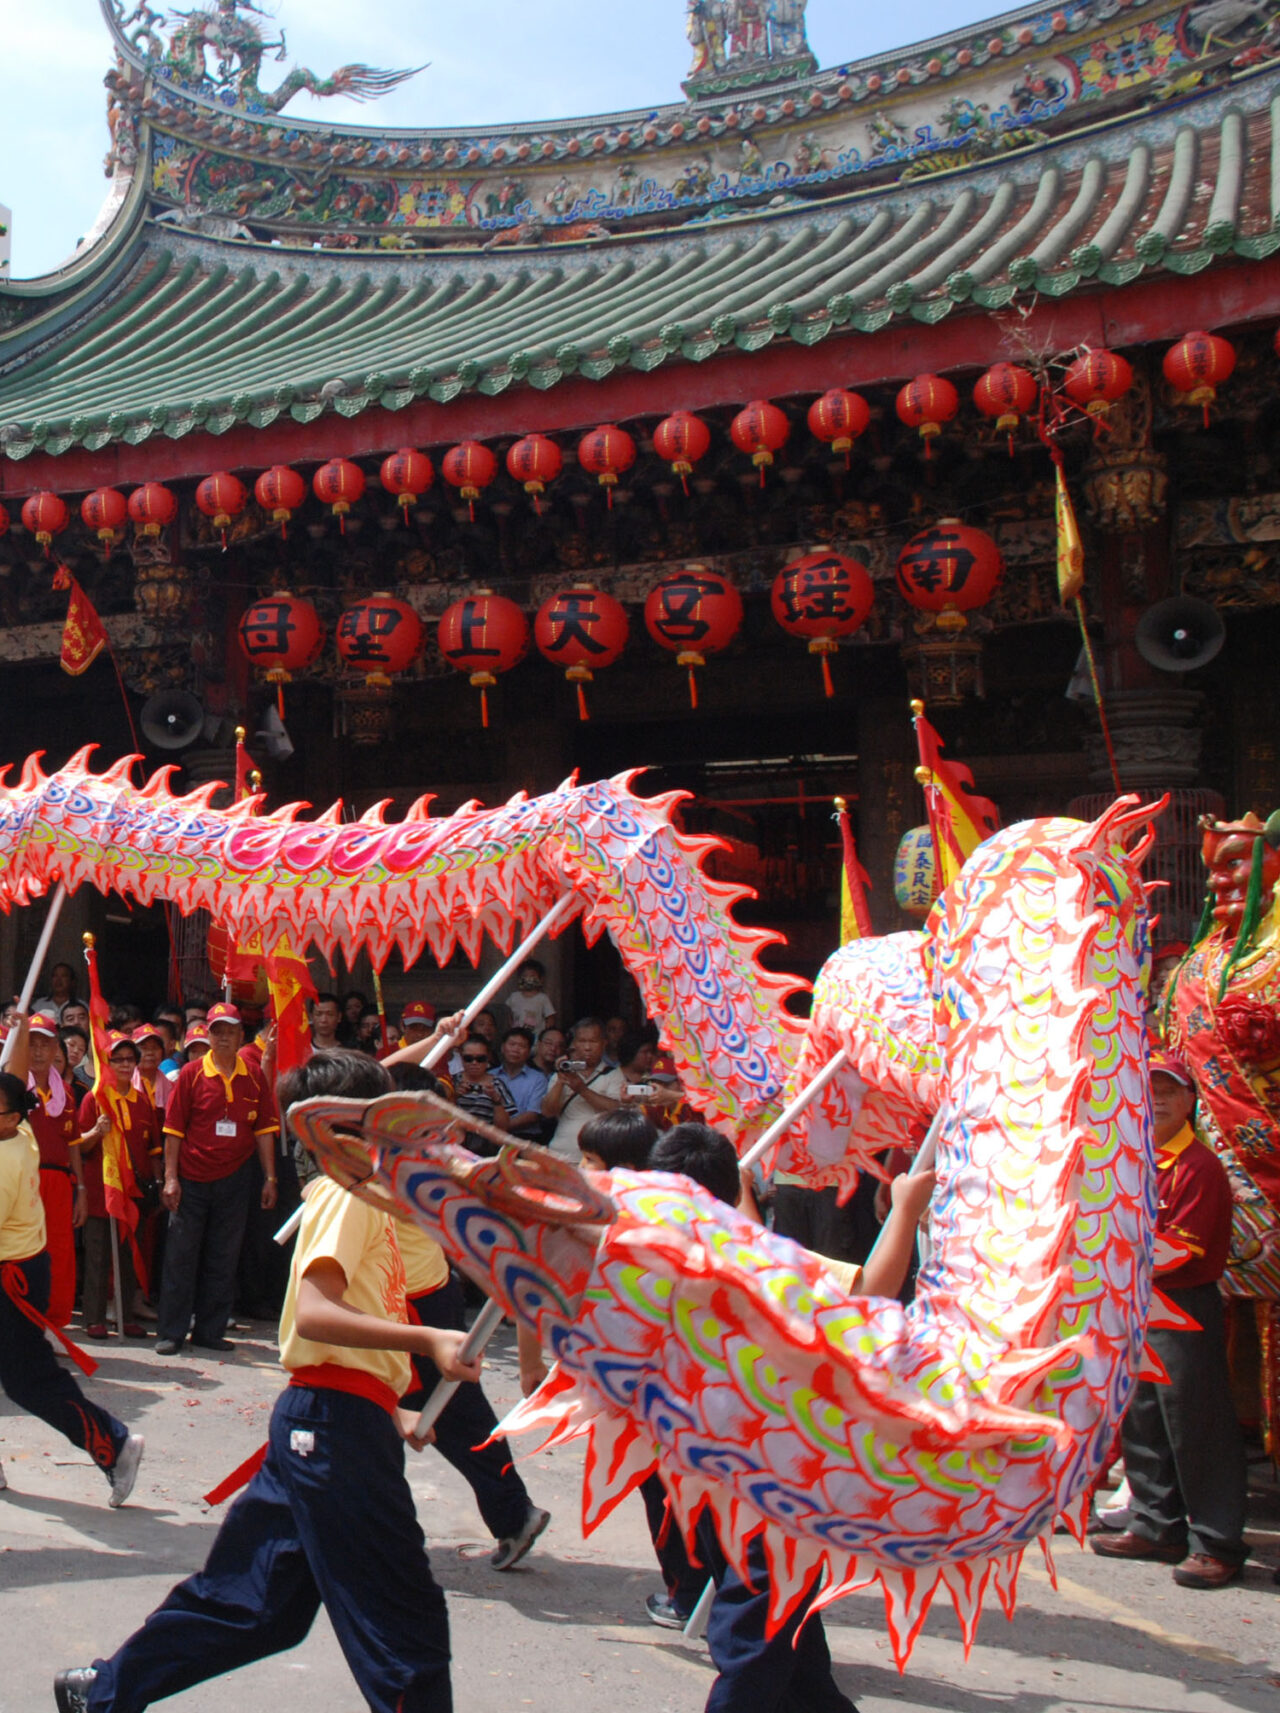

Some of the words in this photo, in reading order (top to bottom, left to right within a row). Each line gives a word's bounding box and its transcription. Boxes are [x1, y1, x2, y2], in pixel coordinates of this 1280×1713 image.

[897, 529, 976, 594] 南
[239, 602, 297, 656] 母
[339, 605, 403, 663] 聖
[445, 601, 501, 659] 上
[545, 593, 611, 655] 天
